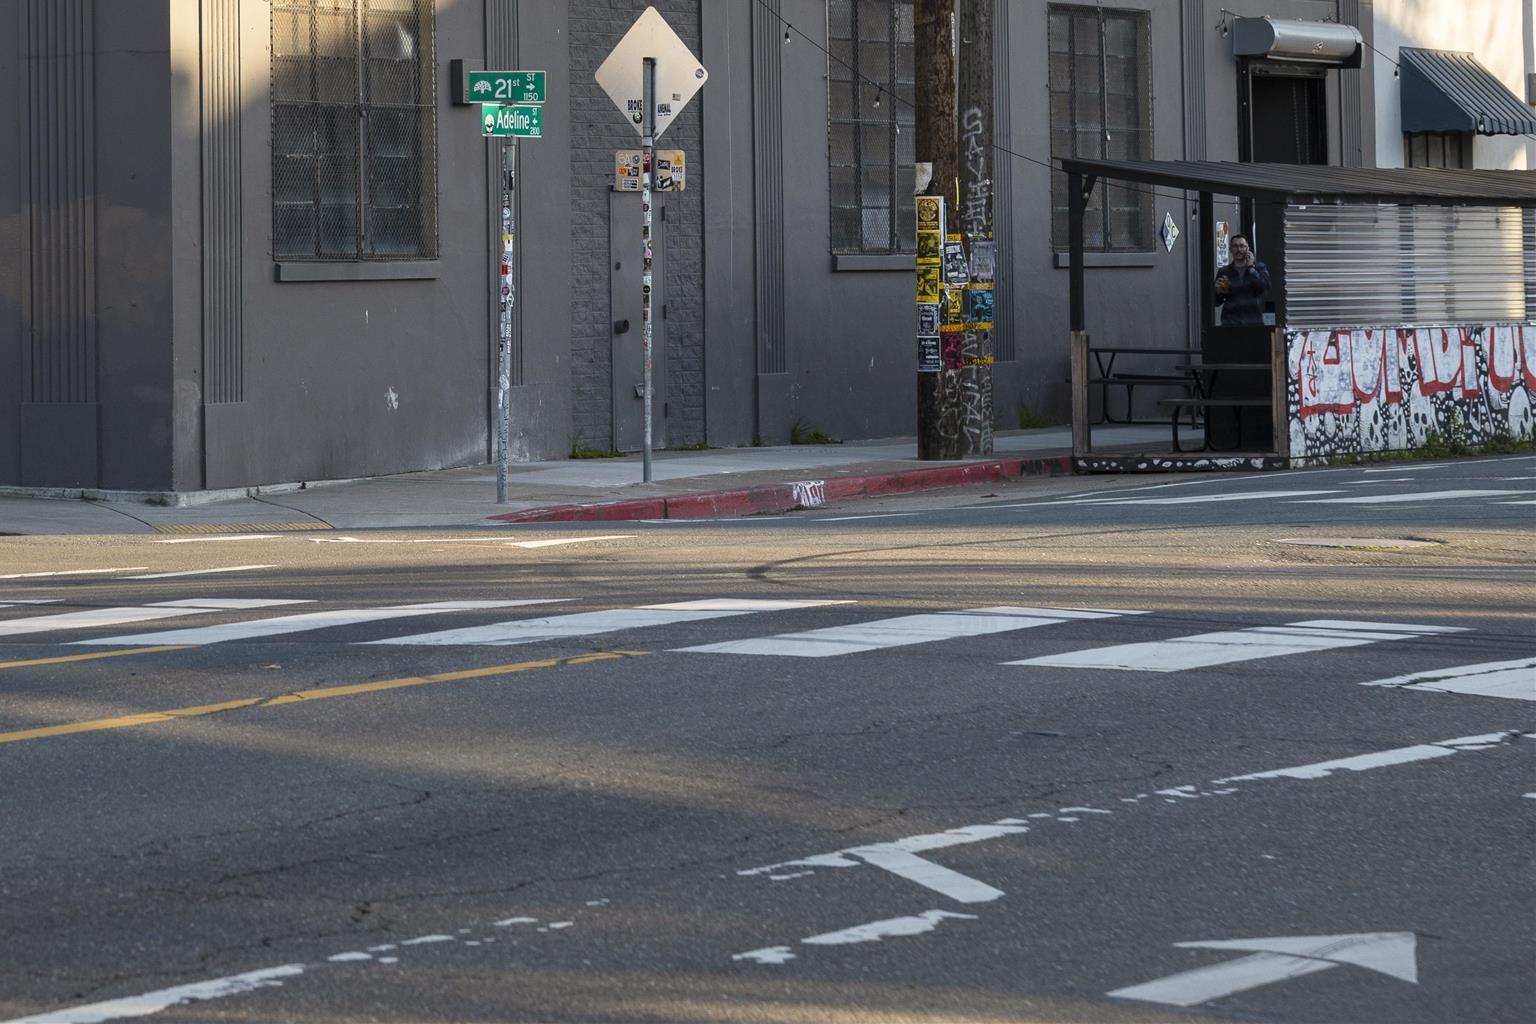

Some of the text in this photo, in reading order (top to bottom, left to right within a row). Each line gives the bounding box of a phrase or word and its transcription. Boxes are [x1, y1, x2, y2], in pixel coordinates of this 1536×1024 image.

[495, 73, 536, 98] 21st ST
[523, 92, 539, 101] 1150
[496, 110, 530, 130] Adeline
